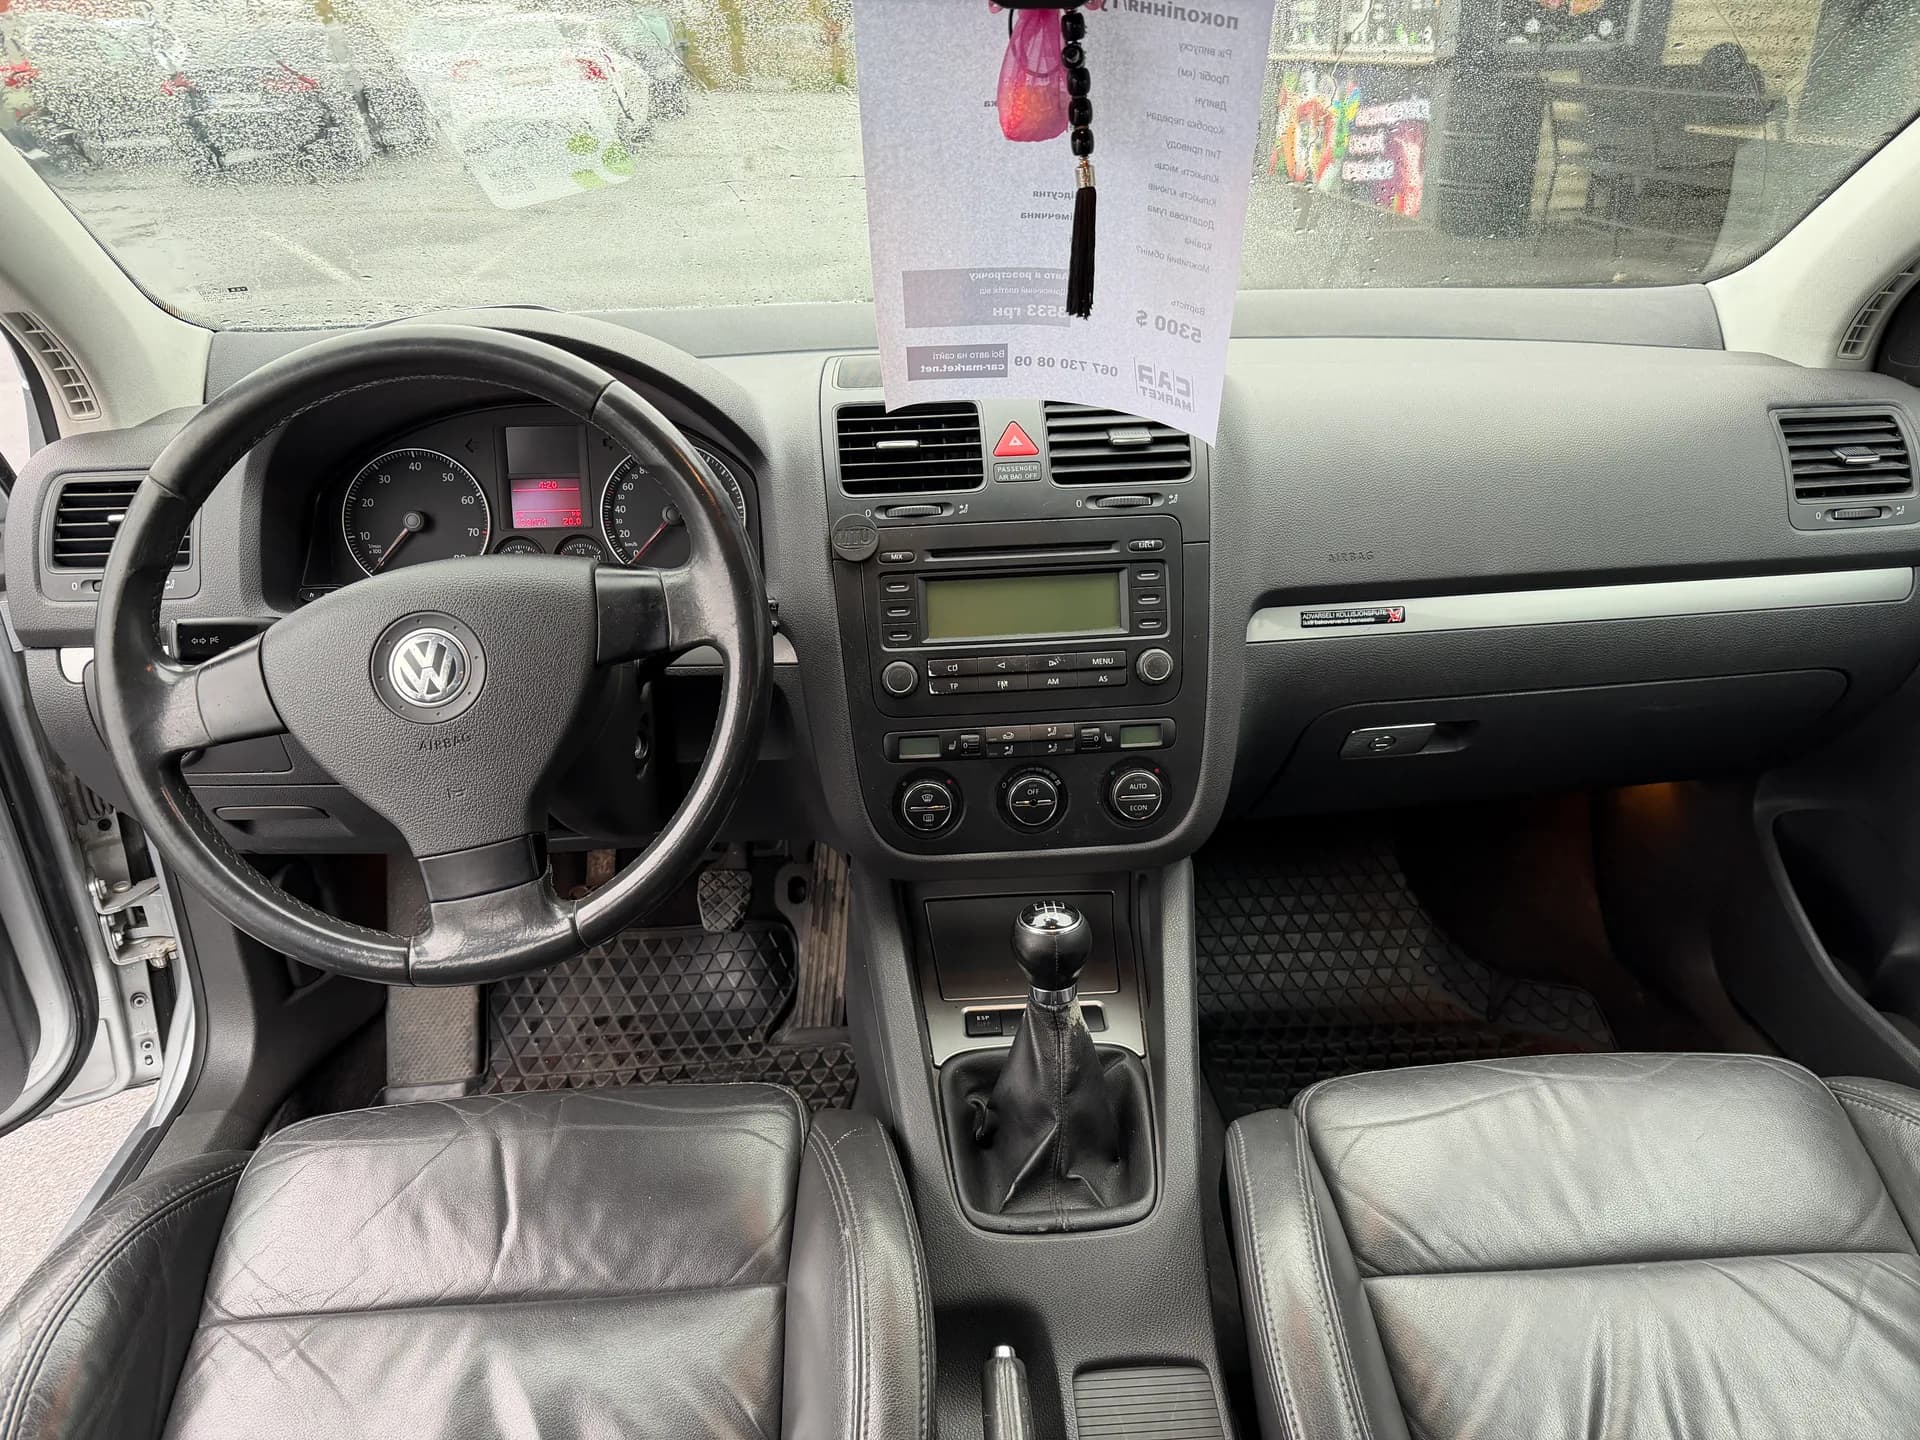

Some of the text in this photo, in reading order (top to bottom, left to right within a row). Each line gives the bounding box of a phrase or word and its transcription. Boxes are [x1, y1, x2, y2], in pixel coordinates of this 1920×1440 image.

[408, 461, 422, 471] 40
[996, 464, 1039, 473] PASSENGER
[378, 474, 391, 484] 30
[441, 472, 455, 482] 50
[538, 481, 558, 489] 4:20
[622, 482, 634, 492] 60
[361, 498, 374, 507] 20
[460, 495, 475, 505] 60
[614, 505, 626, 514] 40
[360, 531, 371, 541] 10
[467, 527, 480, 537] 70
[619, 529, 630, 538] 20
[1326, 550, 1375, 564] AIRBAG
[1092, 657, 1114, 666] MENU
[947, 664, 958, 672] CD
[1047, 677, 1060, 686] AM
[1098, 675, 1108, 683] AS
[950, 682, 959, 690] TP
[418, 732, 472, 751] AIRBAG
[1129, 782, 1148, 791] AUTO
[1027, 788, 1040, 797] OFF
[1129, 804, 1148, 813] ECON
